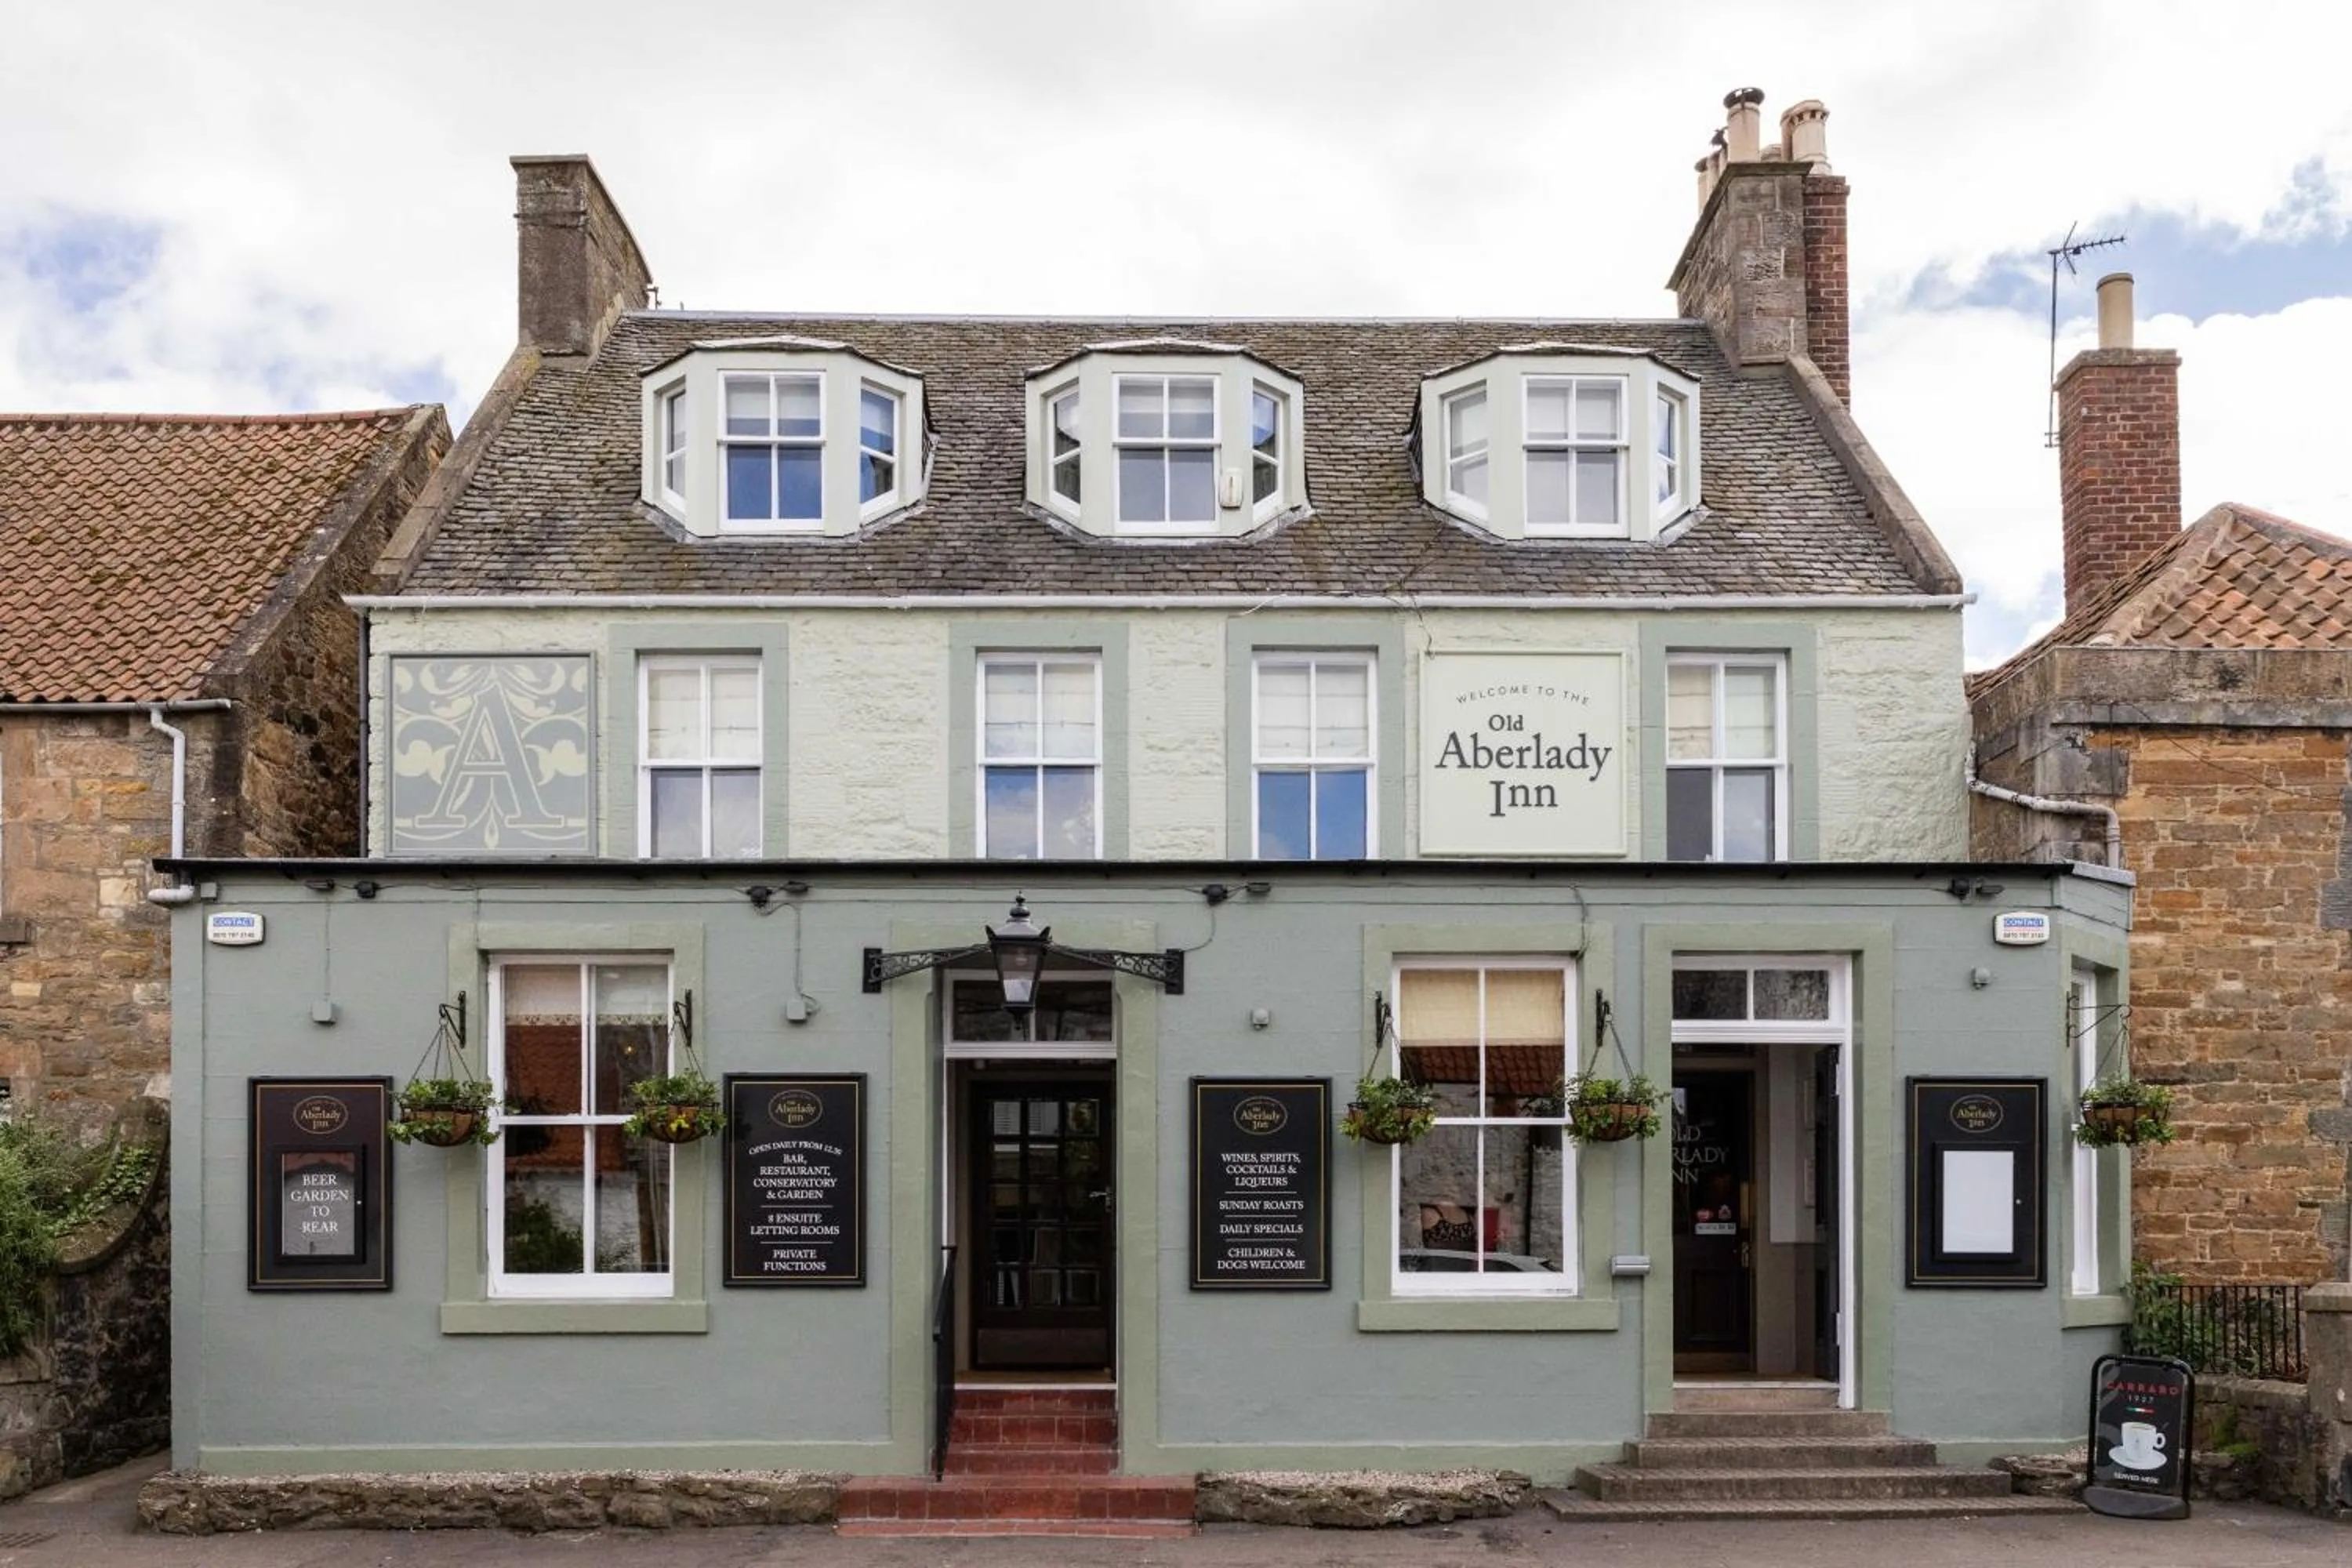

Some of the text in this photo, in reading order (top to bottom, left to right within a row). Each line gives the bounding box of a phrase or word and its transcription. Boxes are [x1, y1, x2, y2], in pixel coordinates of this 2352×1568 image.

[1456, 684, 1590, 706] WELCOME TO THE
[1488, 714, 1524, 731] Old
[1434, 731, 1613, 782] Aberlady
[1489, 780, 1559, 817] Inn
[301, 1109, 341, 1123] Aberlady
[749, 1143, 771, 1155] OPEN
[772, 1141, 797, 1149] DAILY
[799, 1141, 823, 1150] FROM
[783, 1153, 808, 1165] BAR,
[1221, 1153, 1301, 1163] WINES, SPIRITS,
[760, 1166, 831, 1176] RESTAURANT,
[1225, 1165, 1298, 1174] COCKTAILS &
[303, 1174, 337, 1186] BEER
[753, 1178, 838, 1188] CONSERVATORY
[1235, 1177, 1288, 1188] LIQUEURS
[291, 1189, 350, 1202] GARDEN
[766, 1189, 824, 1199] & GARDEN
[1219, 1200, 1304, 1210] SUNDAY ROASTS
[310, 1205, 331, 1217] TO
[768, 1214, 822, 1224] 8 ENSUITE
[301, 1221, 338, 1233] REAR
[750, 1225, 840, 1235] LETTING ROOMS
[1219, 1224, 1304, 1233] DAILY SPECIALS
[773, 1249, 817, 1258] PRIVATE
[1228, 1247, 1296, 1258] CHILDREN &
[764, 1261, 827, 1271] FUNCTIONS
[1218, 1260, 1306, 1269] DOGS WELCOME
